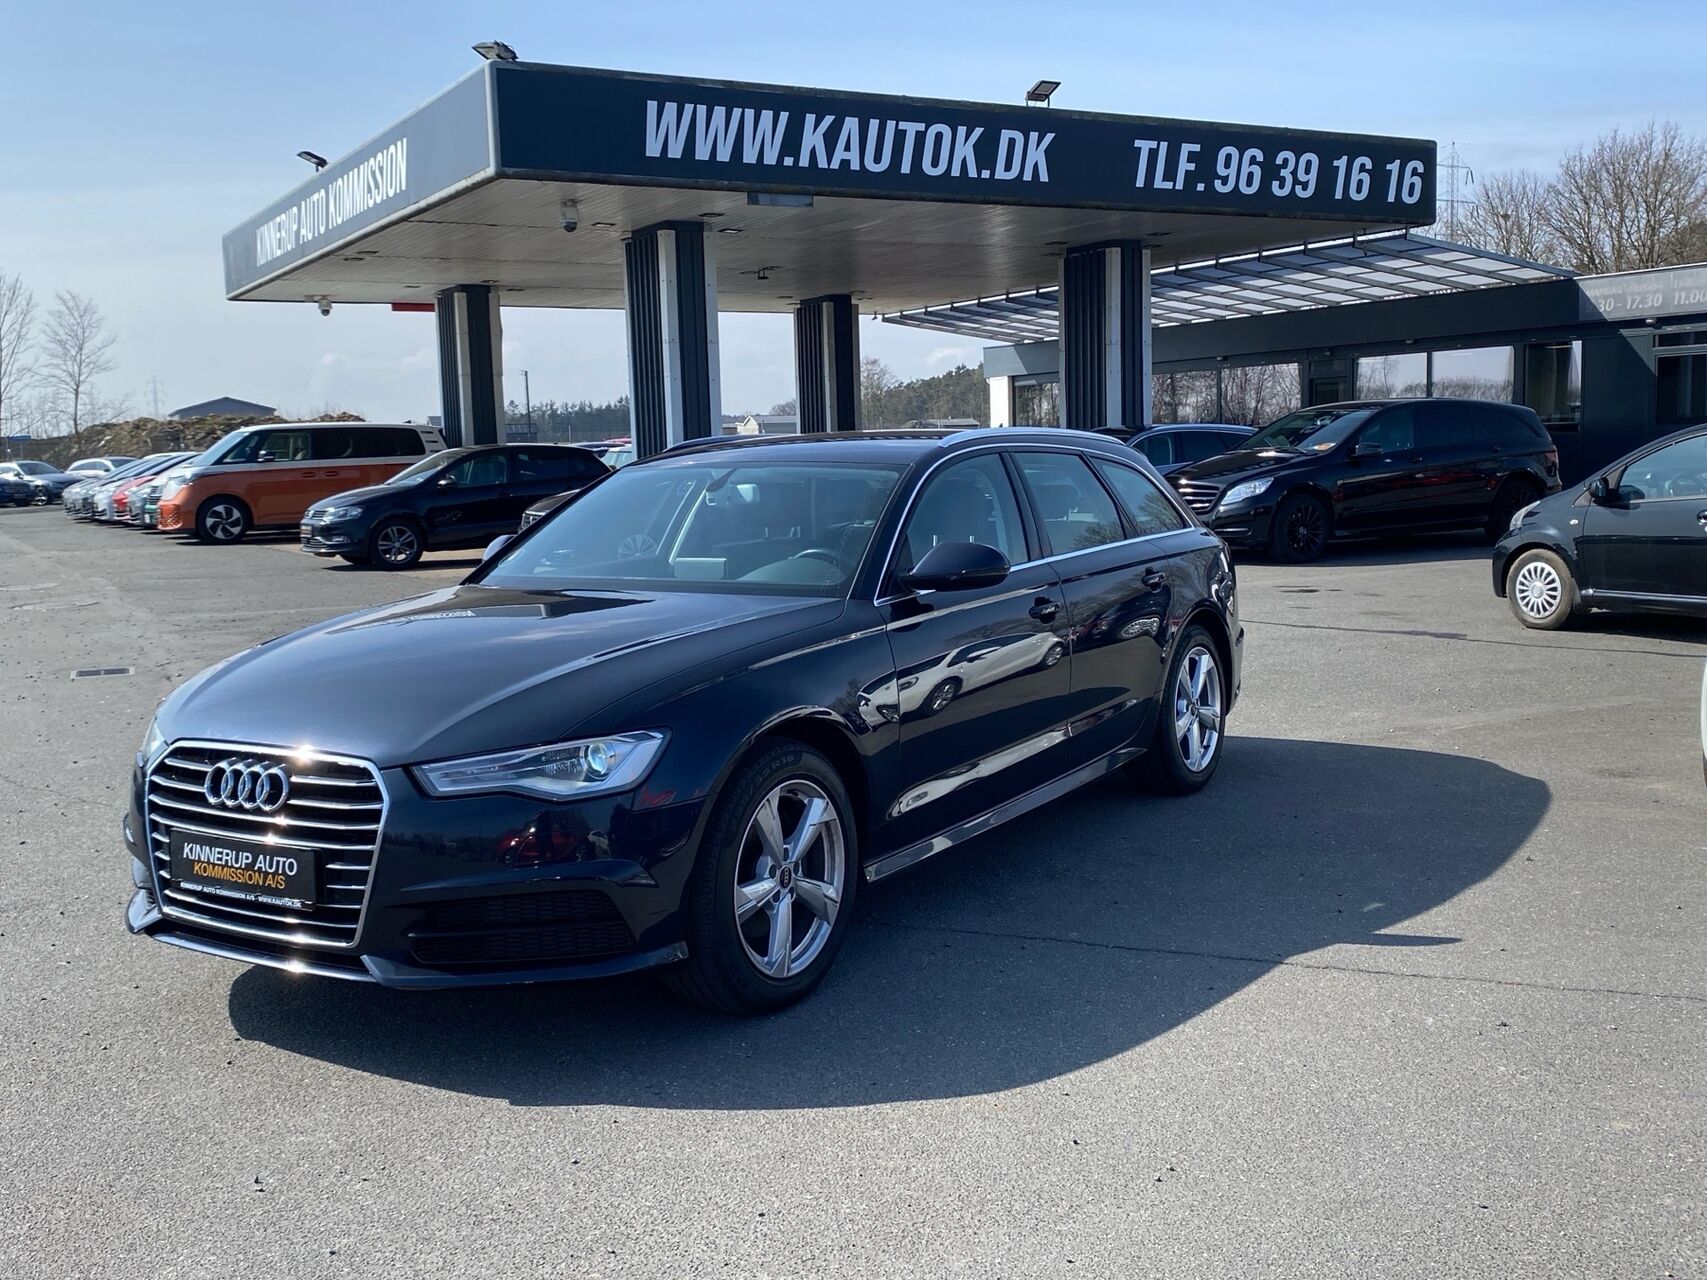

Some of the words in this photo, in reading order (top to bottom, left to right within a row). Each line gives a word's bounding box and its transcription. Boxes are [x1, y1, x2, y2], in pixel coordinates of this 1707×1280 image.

[645, 100, 1057, 183] WWW.KAUTOK.DK
[1133, 139, 1205, 192] TLF.
[1213, 145, 1264, 195] 96
[1271, 150, 1320, 199] 39
[1332, 155, 1373, 202] 16
[1386, 159, 1425, 205] 16
[256, 205, 299, 268] KINNERUP
[300, 188, 326, 245] AUTO
[328, 137, 407, 230] KOMMISSION
[1626, 293, 1663, 310] 17.30
[183, 842, 252, 869] KINNERUP
[254, 854, 298, 876] AUTO
[193, 861, 263, 886] KOMMISSION
[265, 874, 286, 889] A/S
